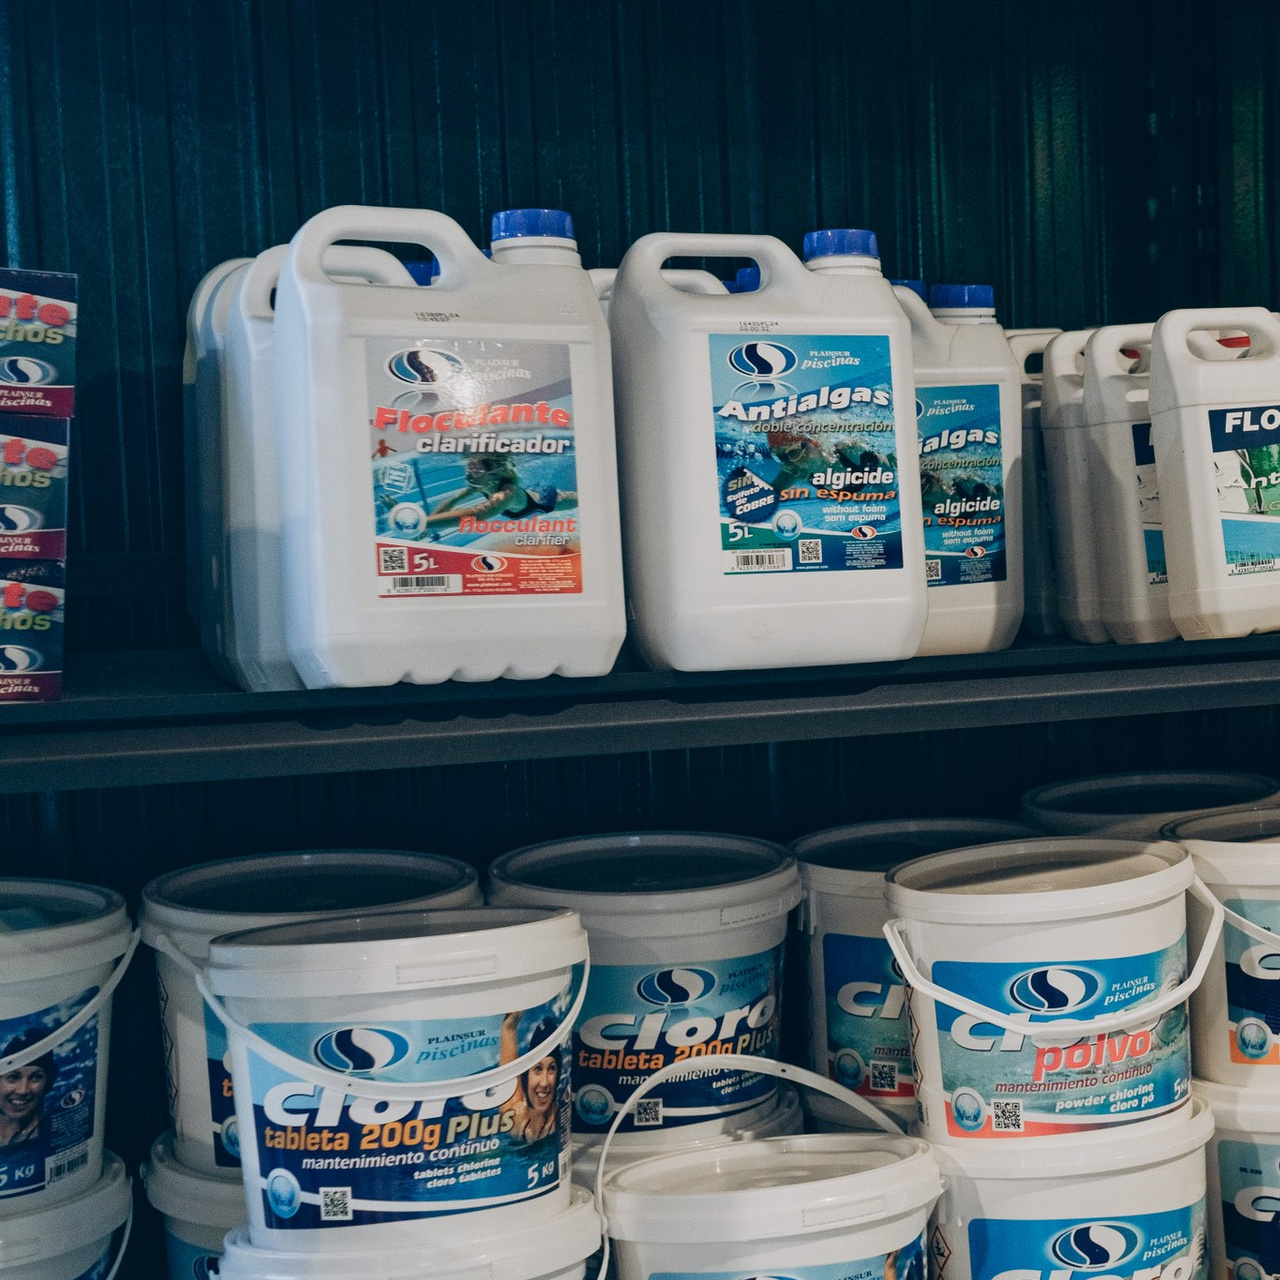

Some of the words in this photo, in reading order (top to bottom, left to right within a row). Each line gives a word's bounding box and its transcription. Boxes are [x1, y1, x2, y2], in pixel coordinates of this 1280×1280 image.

[801, 354, 860, 370] piscinas
[717, 386, 890, 421] Antialgas
[373, 401, 571, 433] Floculante
[752, 421, 792, 433] doble
[797, 420, 893, 433] concentración
[416, 433, 570, 453] clarificador
[811, 468, 894, 489] algicide
[779, 487, 809, 501] sin
[816, 487, 896, 503] espuma
[736, 494, 775, 515] COBRE
[822, 504, 859, 514] without
[861, 504, 886, 513] foam
[934, 498, 1001, 516] algicide
[458, 516, 577, 534] flocculant
[825, 514, 845, 522] sem
[848, 513, 886, 523] espuma
[936, 514, 1001, 527] espuma
[514, 533, 570, 546] clarifier
[729, 522, 754, 542] 5L
[942, 529, 972, 538] without
[1104, 981, 1156, 1005] piscinas
[428, 1030, 486, 1045] PLAINSUR
[578, 1046, 664, 1071] tableta
[1033, 1030, 1151, 1082] polvo
[1055, 1095, 1106, 1112] powder
[1109, 1083, 1154, 1103] chlorine
[1110, 1099, 1138, 1113] cloro
[264, 1126, 350, 1151] tableta
[360, 1120, 442, 1151] 200g
[446, 1110, 516, 1144] Plus
[302, 1152, 424, 1170] mantenimiento
[430, 1138, 500, 1162] continuo
[413, 1168, 454, 1180] tablets
[460, 1167, 501, 1184] tabletes
[527, 1163, 540, 1188] 5
[1150, 1230, 1182, 1246] PLAINSUR
[1143, 1237, 1188, 1261] piscinas
